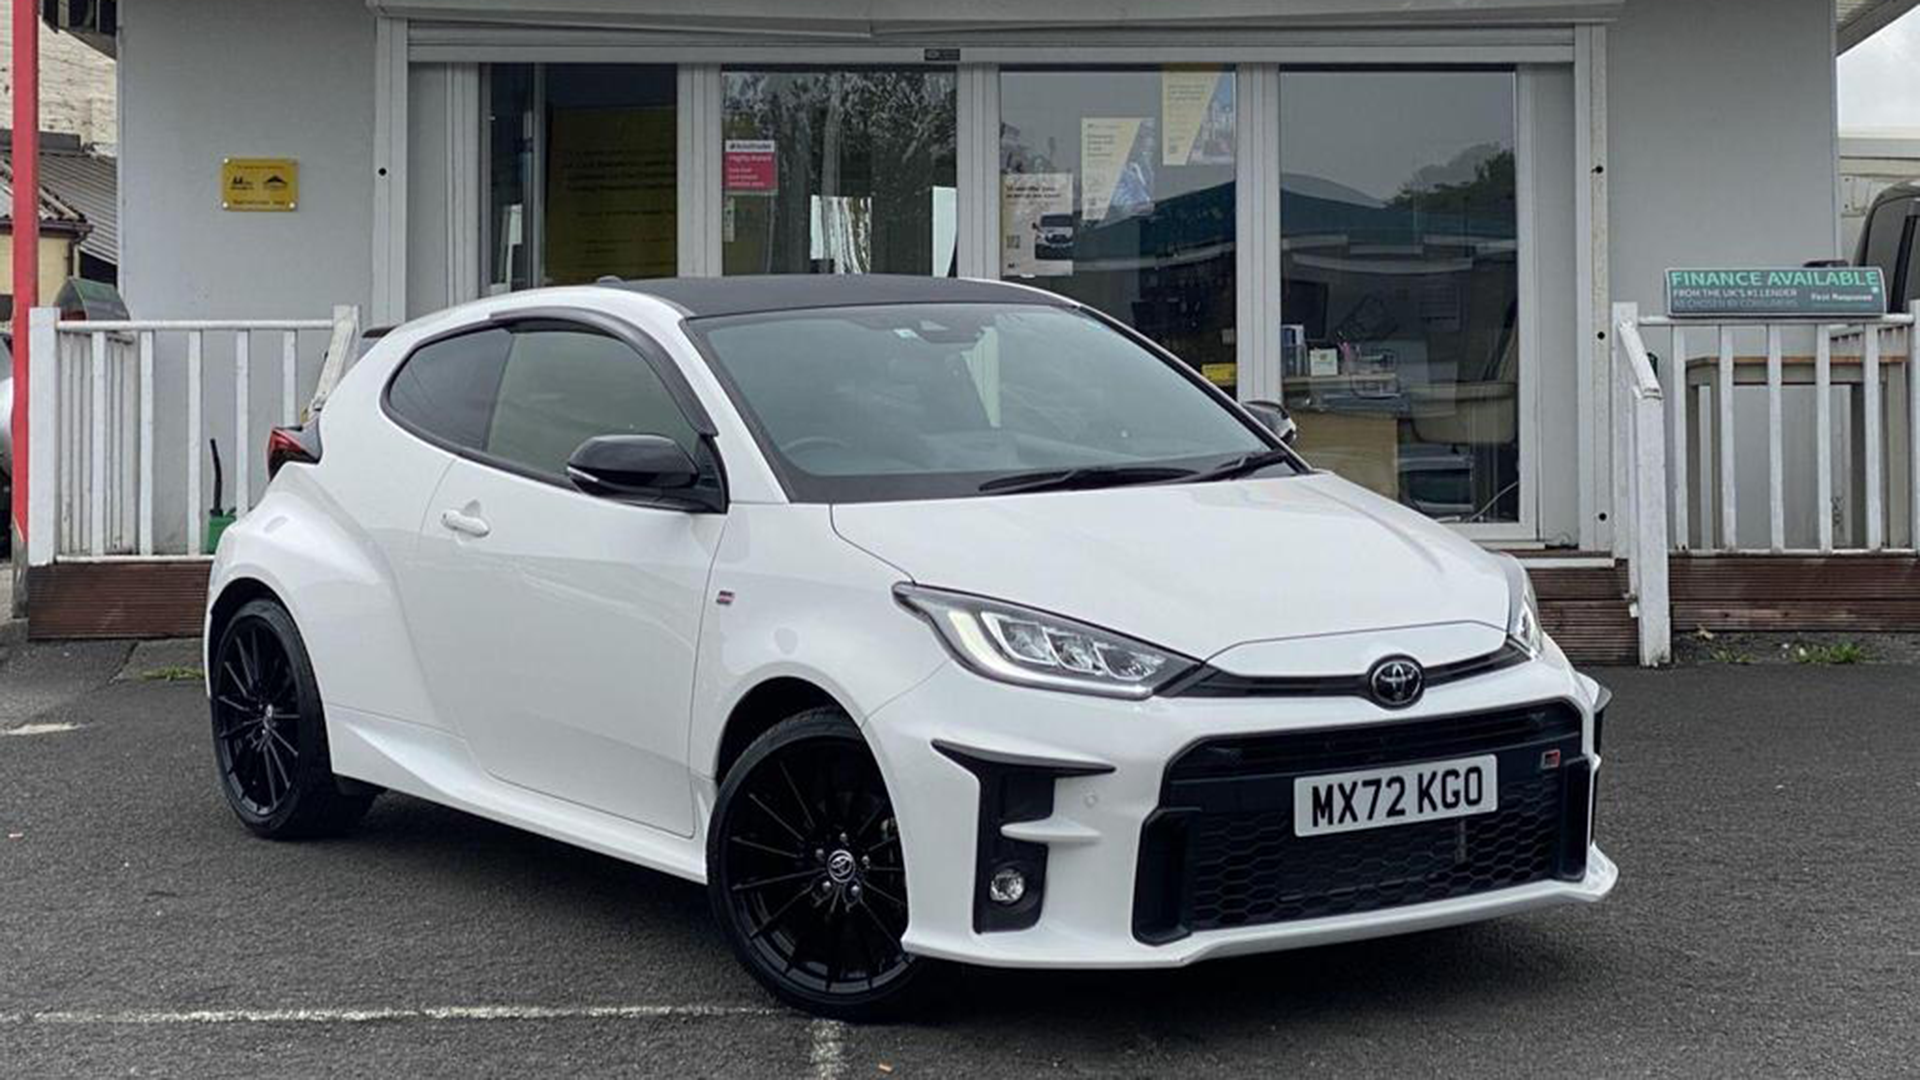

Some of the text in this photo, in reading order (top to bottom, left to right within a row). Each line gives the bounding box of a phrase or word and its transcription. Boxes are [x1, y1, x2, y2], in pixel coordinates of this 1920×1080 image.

[1671, 271, 1879, 286] FINANCE AVAILABLE
[1673, 288, 1700, 298] FROM
[1703, 288, 1720, 298] THE
[1722, 288, 1746, 298] UK'S
[1758, 288, 1797, 298] LENDER
[1312, 767, 1482, 827] MX72 KGO
